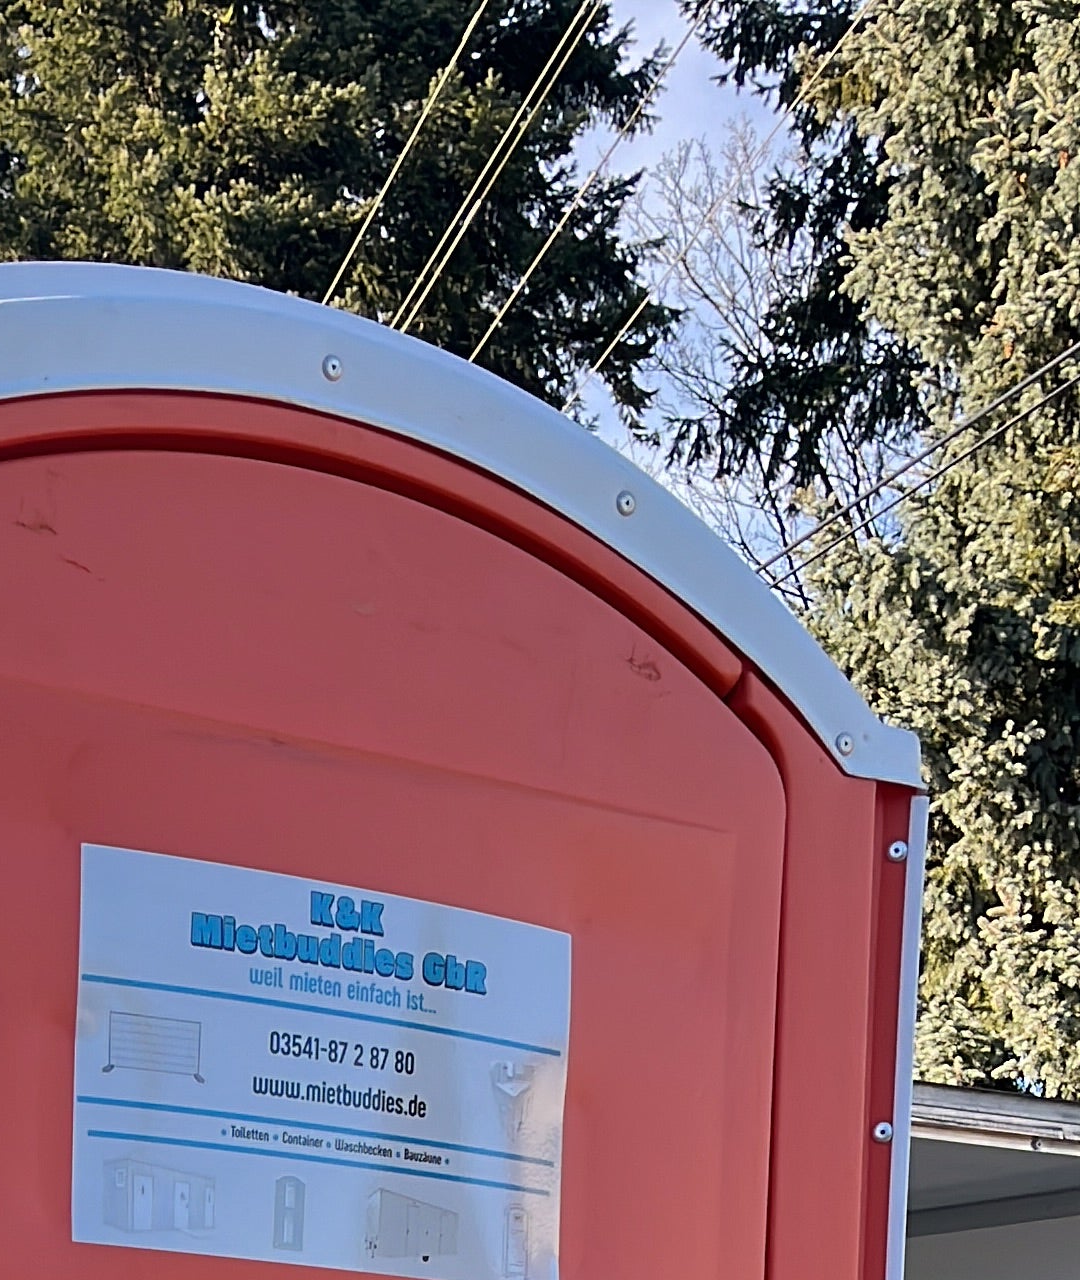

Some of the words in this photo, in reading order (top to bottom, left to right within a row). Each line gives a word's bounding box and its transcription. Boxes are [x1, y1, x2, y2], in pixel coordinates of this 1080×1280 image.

[311, 890, 384, 937] K&K
[190, 911, 414, 981] Mietbuddies
[422, 952, 487, 995] GbR
[249, 966, 283, 989] weil
[289, 972, 341, 1000] mieten
[347, 980, 401, 1009] einfach
[406, 989, 437, 1014] ist...
[270, 1031, 348, 1065] 03541-87
[353, 1043, 364, 1067] 2
[369, 1046, 389, 1071] 87
[394, 1050, 415, 1075] 80
[252, 1075, 427, 1118] www.mietbuddies.de
[230, 1125, 270, 1143] Toiletten
[282, 1131, 324, 1149] Container
[334, 1138, 393, 1159] Waschbecken
